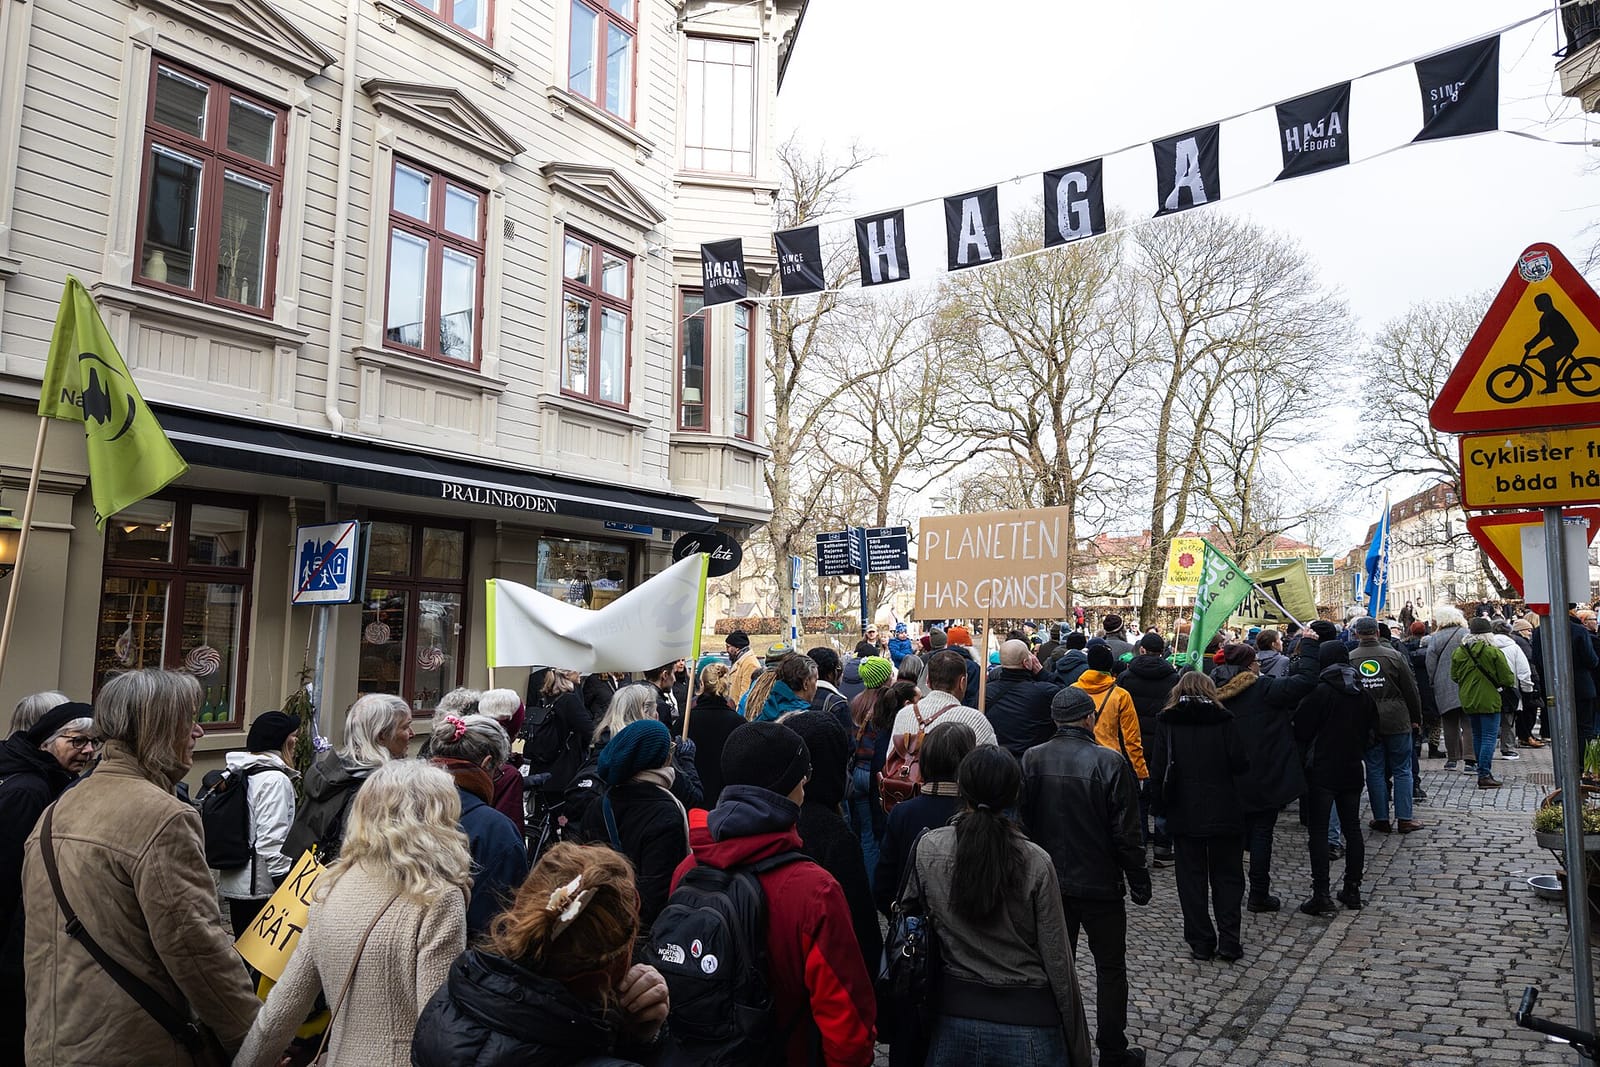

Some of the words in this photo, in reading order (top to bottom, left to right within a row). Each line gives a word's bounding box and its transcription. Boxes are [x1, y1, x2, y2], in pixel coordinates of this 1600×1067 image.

[1298, 137, 1336, 153] EBORG
[782, 253, 804, 264] SINCE
[704, 260, 742, 280] HAGA
[1470, 444, 1574, 469] Cyklister
[1496, 473, 1557, 493] båda
[441, 482, 557, 514] PRALINBODEN
[925, 517, 1059, 561] PLANETEN
[681, 540, 733, 560] Chlate
[923, 580, 969, 609] HAR
[974, 571, 1067, 609] GRÄNSER
[253, 904, 303, 951] RÄT
[658, 948, 677, 957] NORTH
[667, 943, 677, 951] THE
[661, 954, 677, 962] FACE
